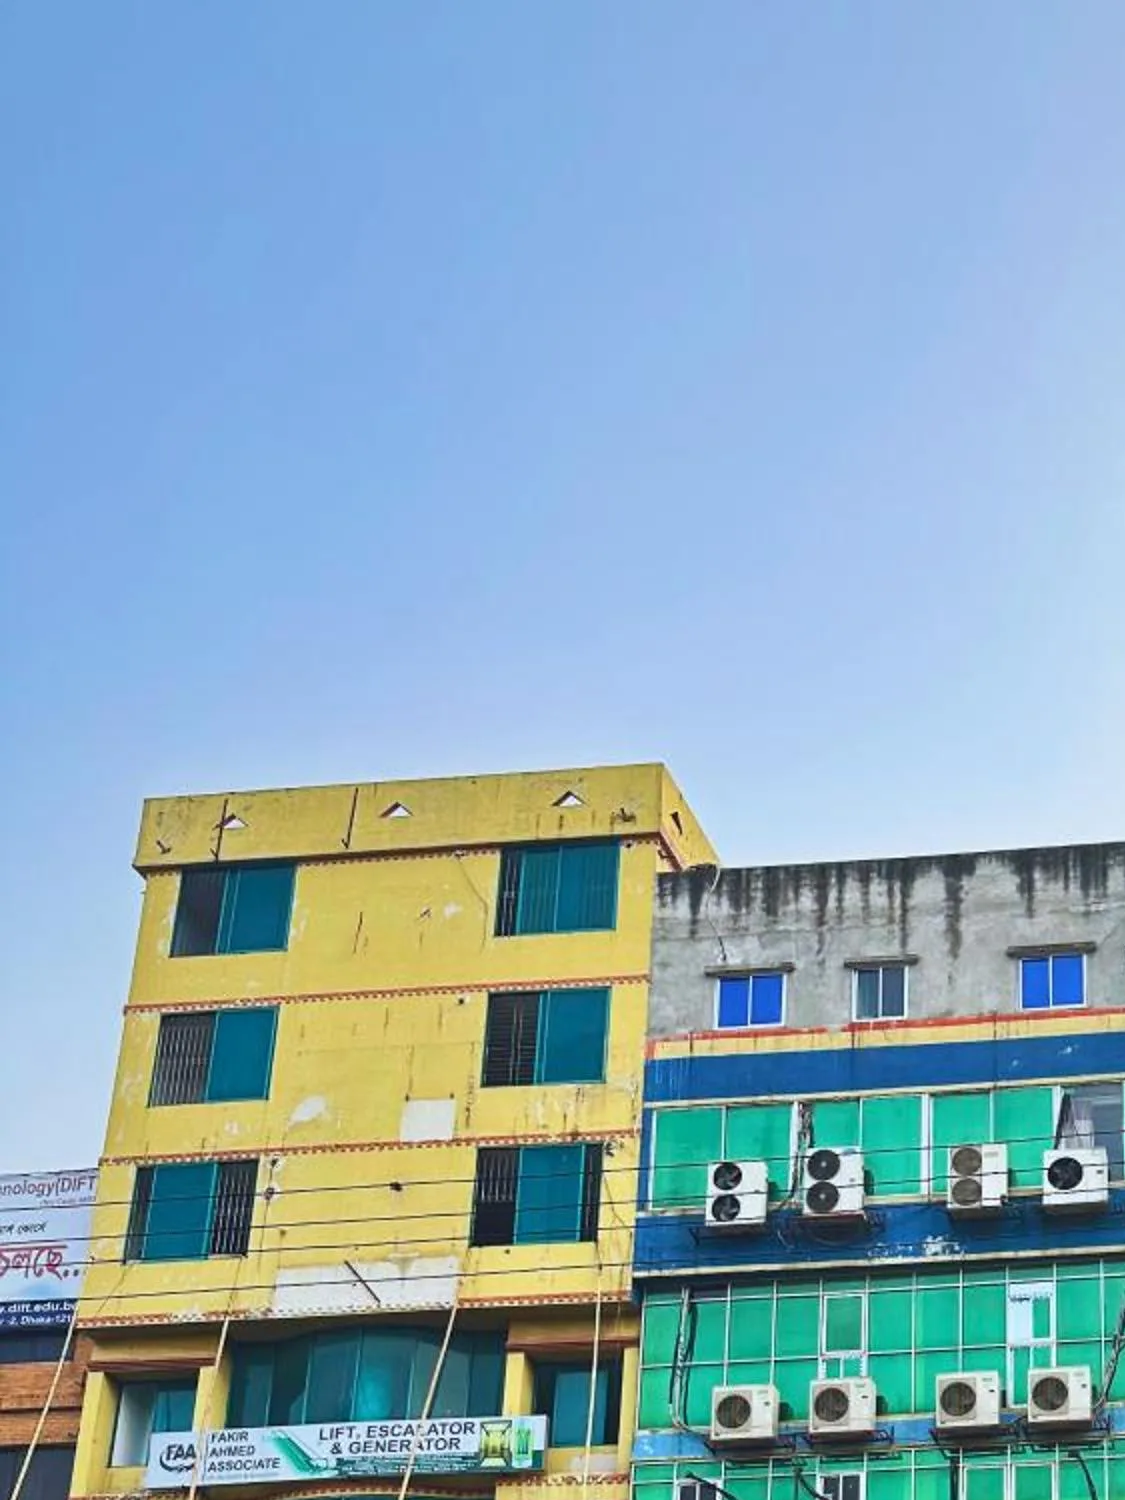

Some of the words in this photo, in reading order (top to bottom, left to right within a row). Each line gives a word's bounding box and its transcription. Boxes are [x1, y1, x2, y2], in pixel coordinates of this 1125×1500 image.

[209, 1445, 255, 1457] AHMED
[330, 1442, 343, 1455] &
[207, 1457, 281, 1473] ASSOCIATE
